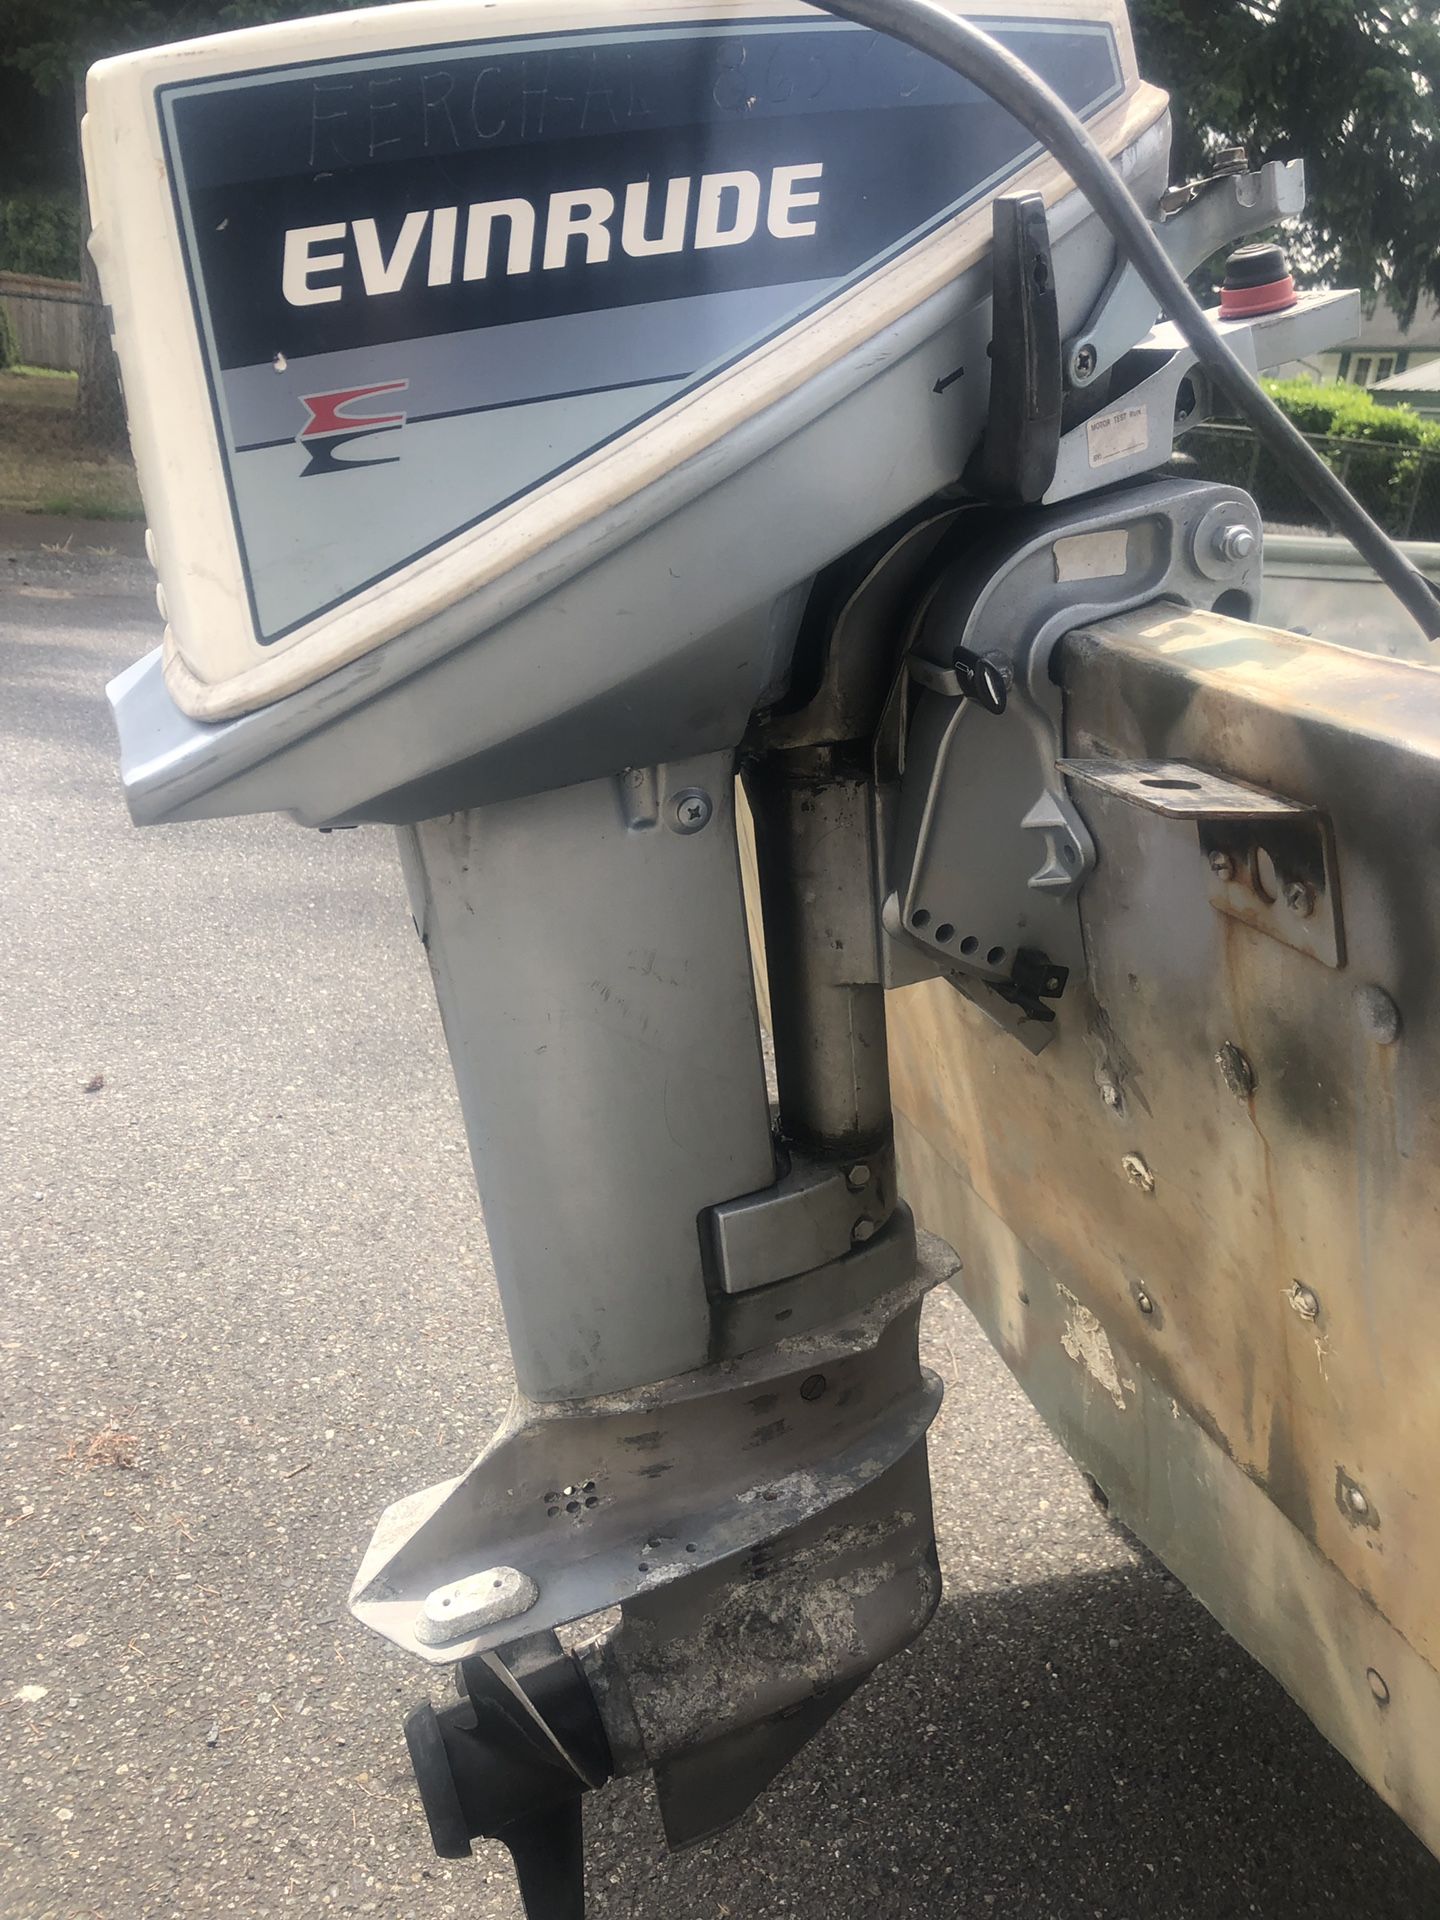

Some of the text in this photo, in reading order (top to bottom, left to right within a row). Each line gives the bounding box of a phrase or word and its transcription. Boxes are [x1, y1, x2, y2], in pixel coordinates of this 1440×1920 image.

[281, 163, 823, 306] EVINRUDE
[1090, 418, 1110, 431] MOTOR
[1113, 412, 1127, 424] TEST
